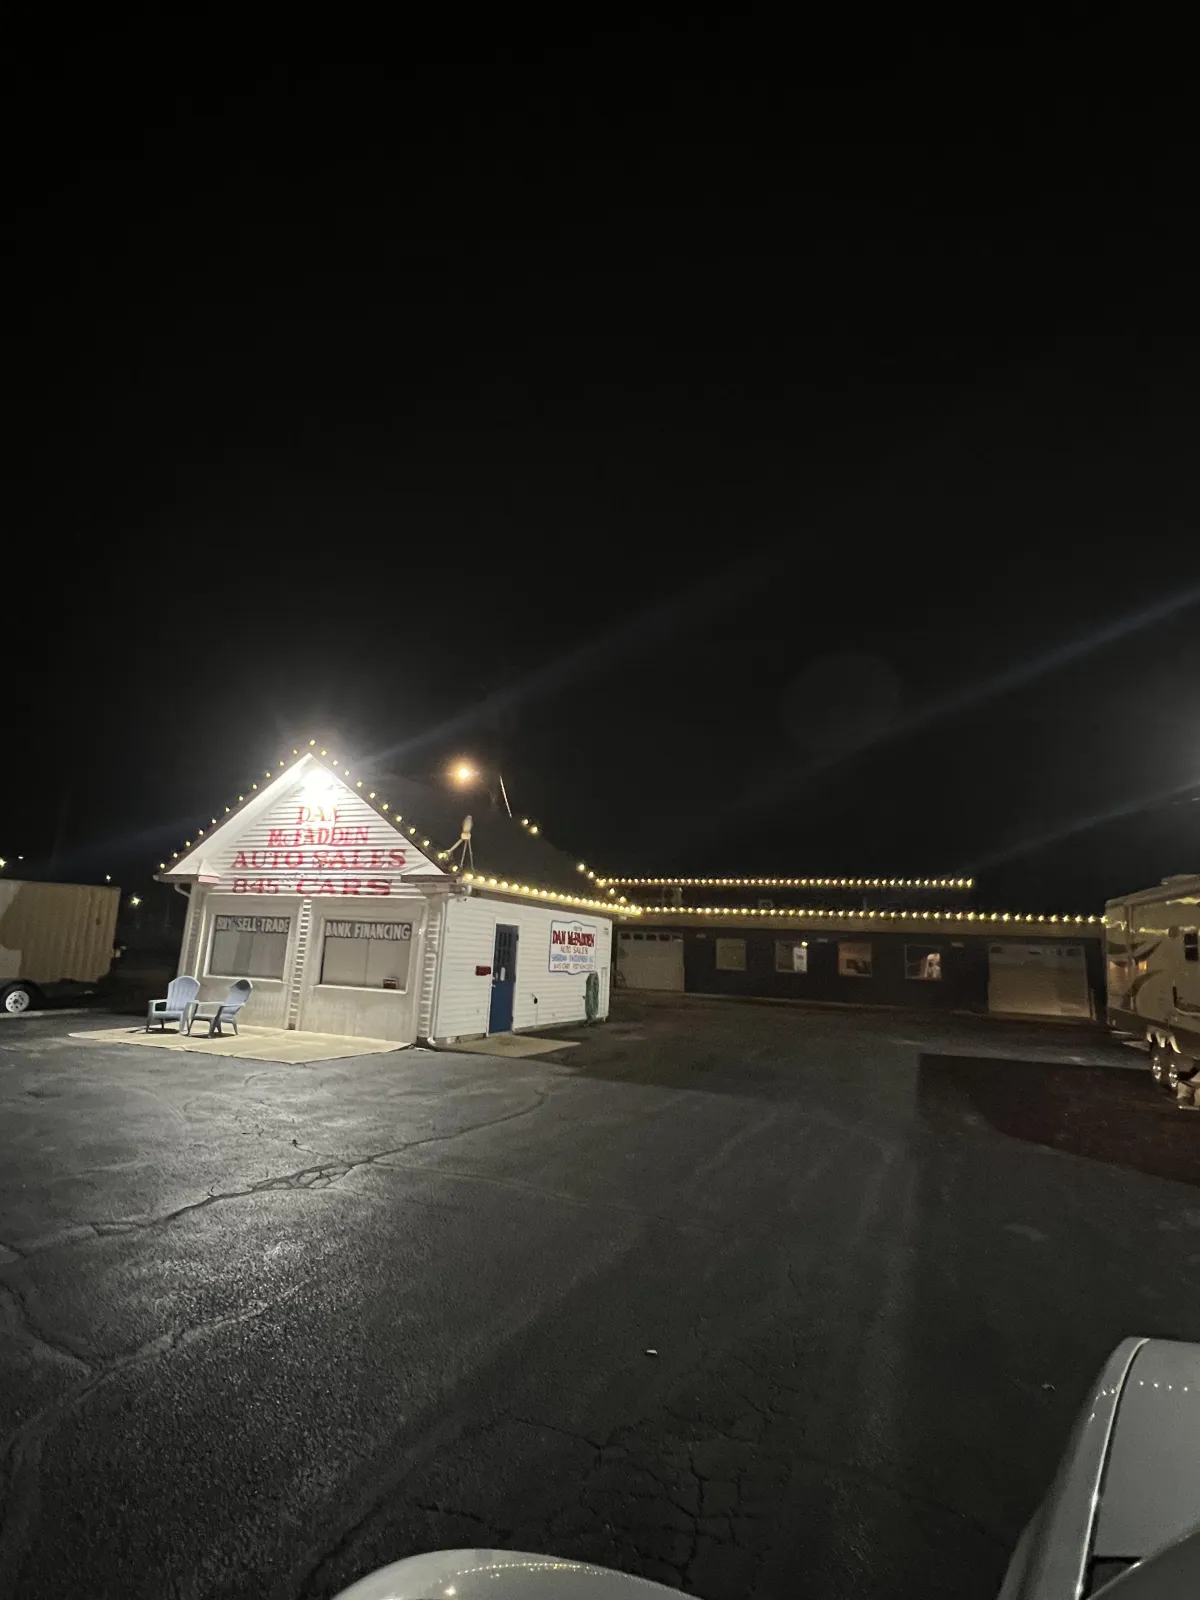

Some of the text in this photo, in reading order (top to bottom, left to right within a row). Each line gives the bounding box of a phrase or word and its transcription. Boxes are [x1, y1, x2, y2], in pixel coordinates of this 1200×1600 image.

[231, 849, 408, 869] AUTO SALES
[232, 878, 393, 896] 845 CARS
[236, 917, 257, 931] SELL
[260, 919, 291, 934] TRADE
[325, 921, 412, 941] BANK FINANCING
[552, 930, 566, 945] DAN
[561, 946, 589, 955] AUTO SALES
